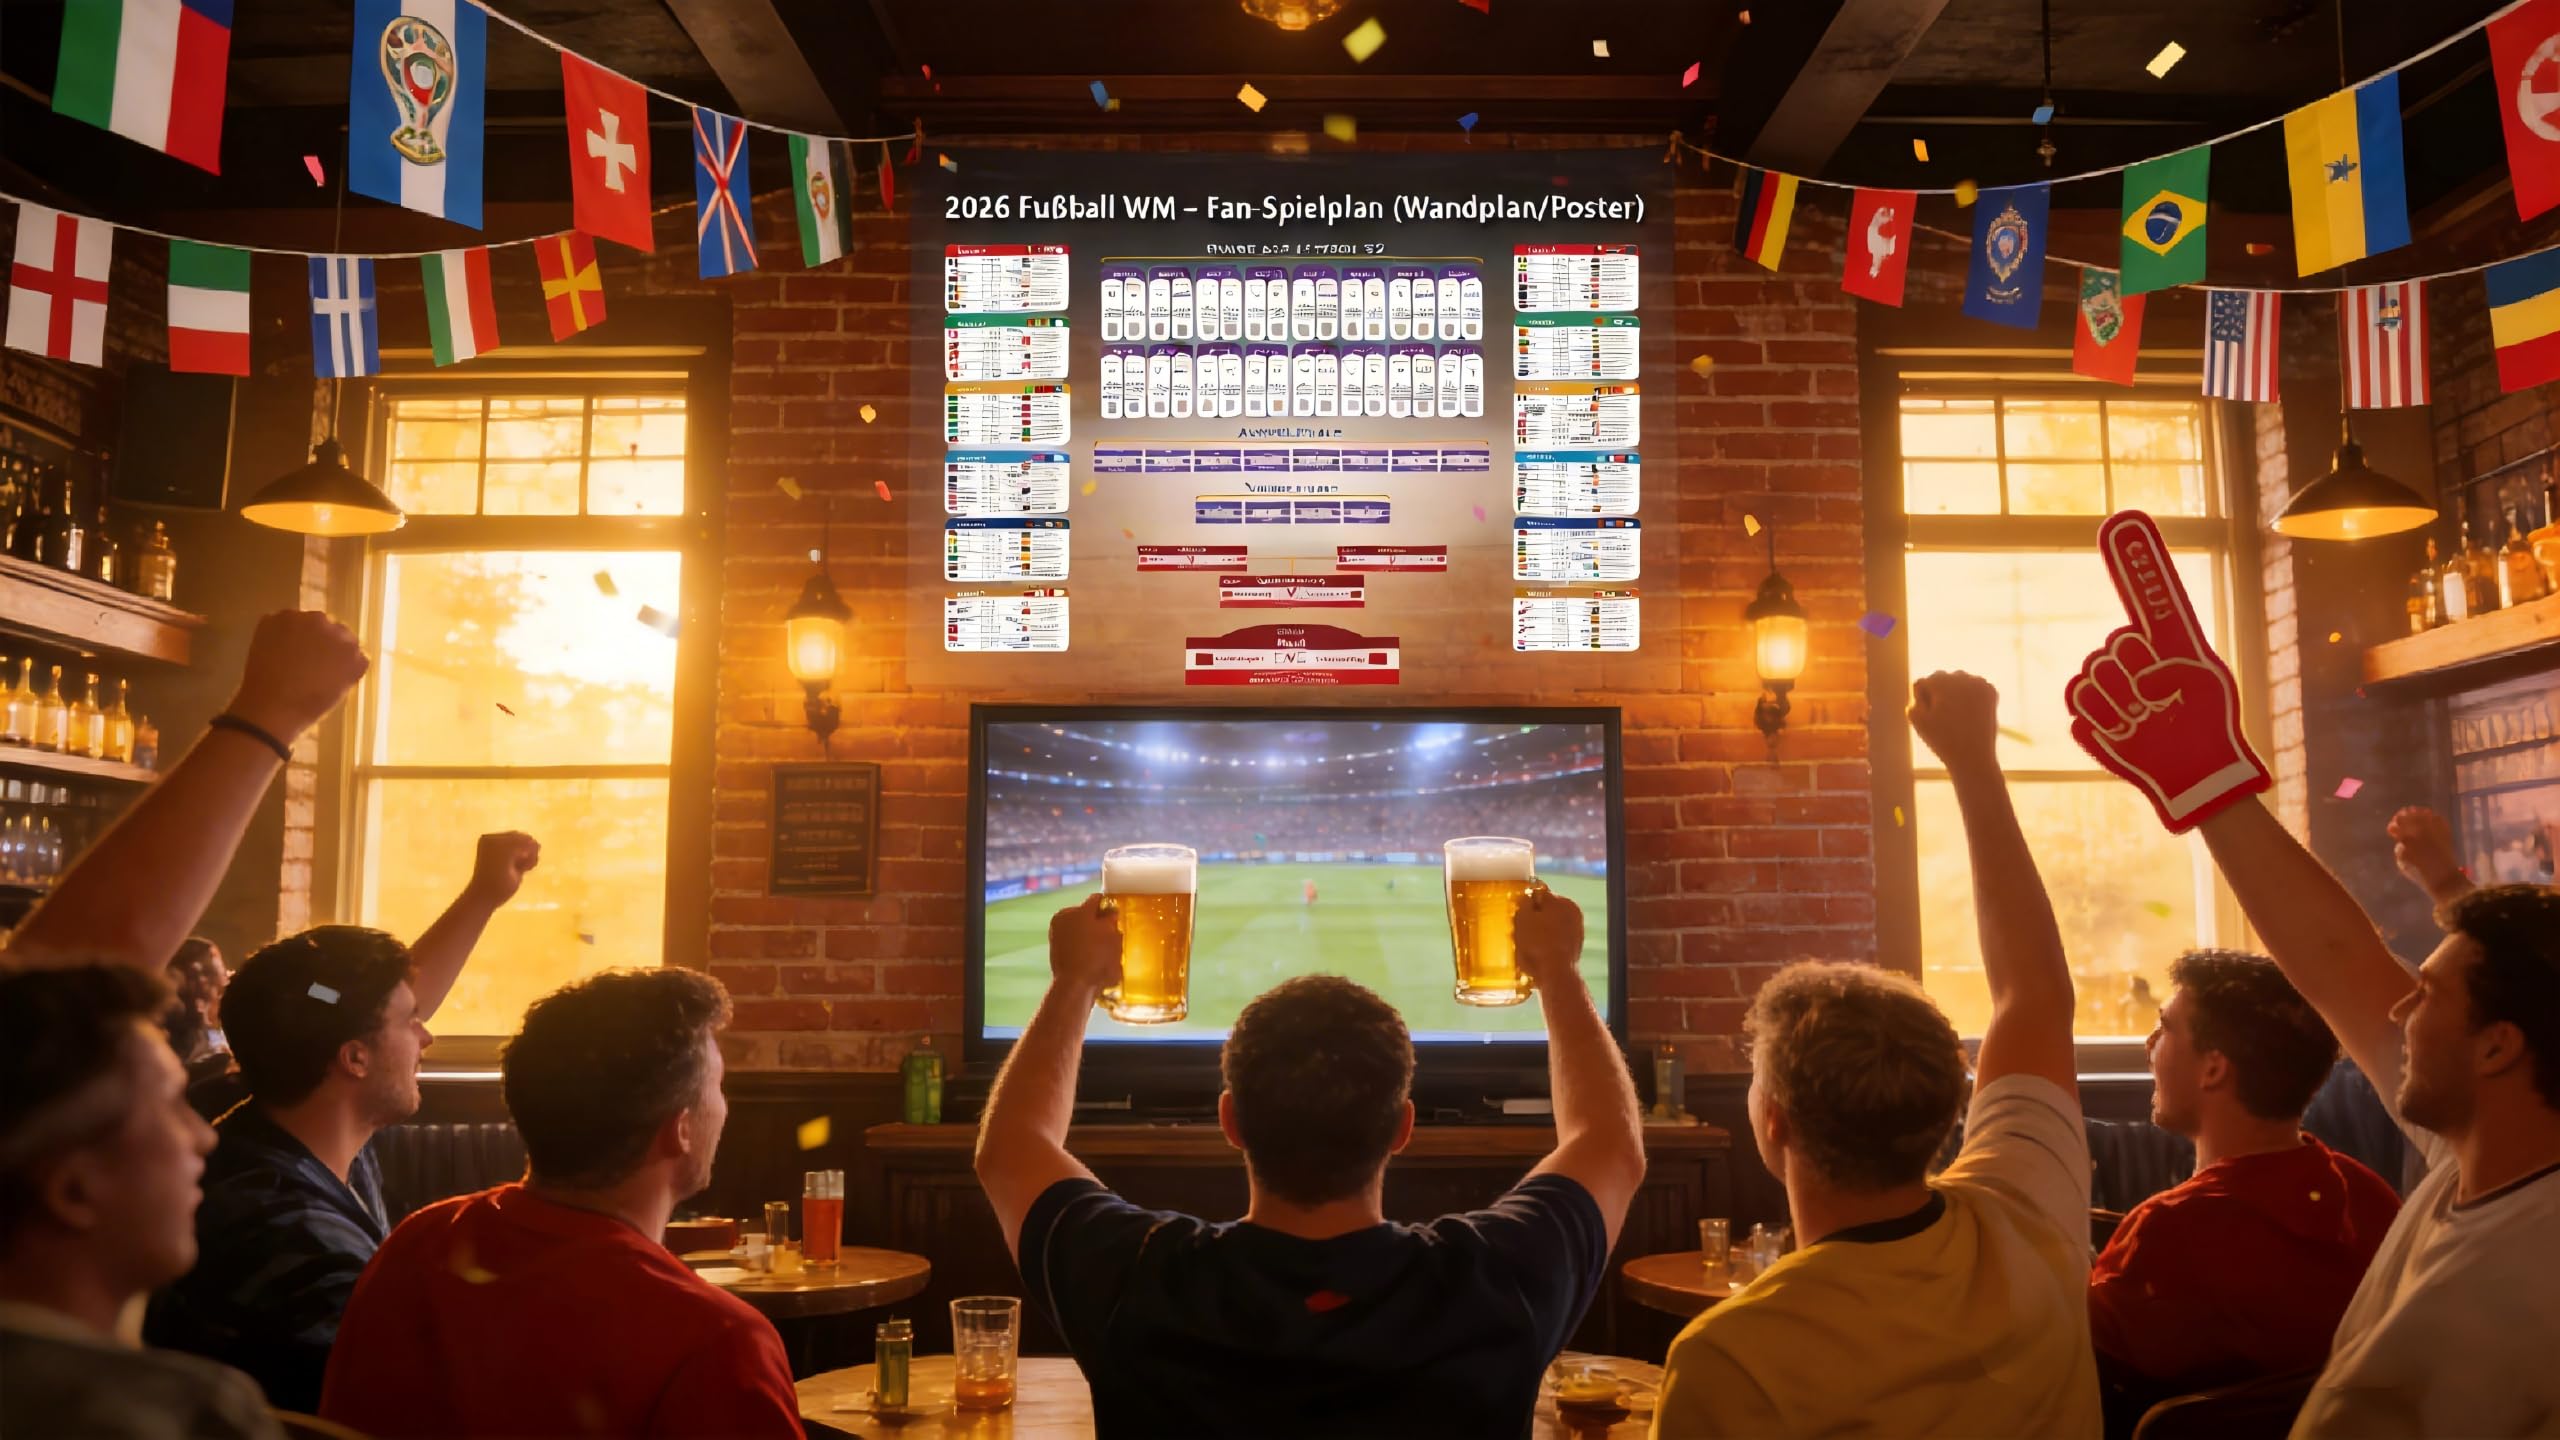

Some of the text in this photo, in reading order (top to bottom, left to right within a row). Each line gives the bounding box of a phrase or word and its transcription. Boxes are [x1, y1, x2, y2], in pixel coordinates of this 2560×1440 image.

[945, 195, 1010, 219] 2026
[1019, 193, 1115, 220] Fußball
[1122, 195, 1176, 221] WM
[1207, 194, 1383, 227] Fan-Spielplan
[1393, 194, 1644, 224] (Wandplan/Poster)
